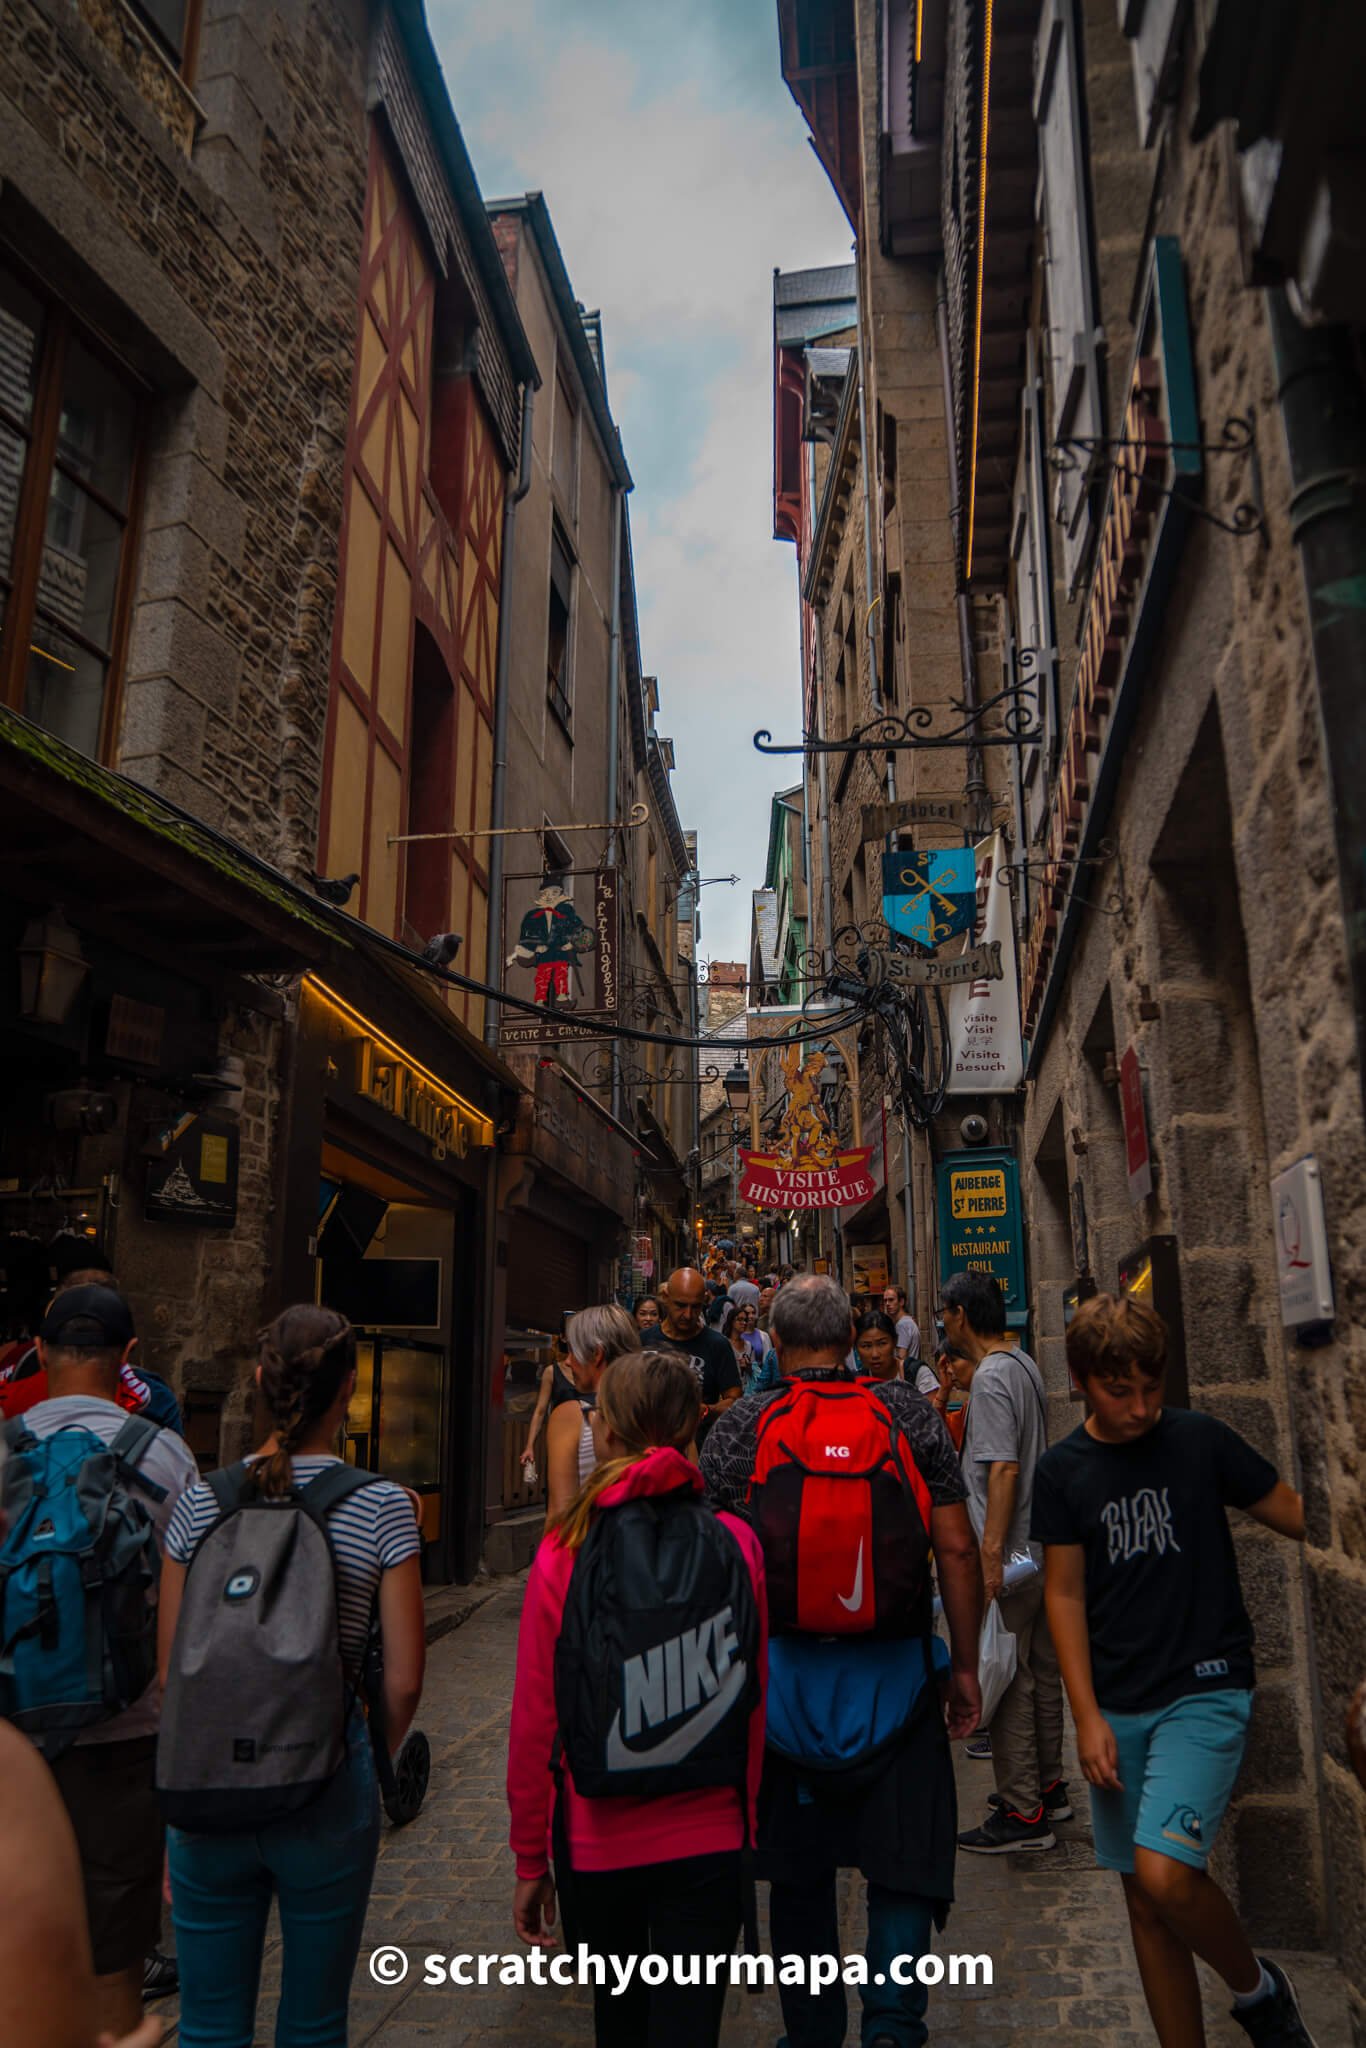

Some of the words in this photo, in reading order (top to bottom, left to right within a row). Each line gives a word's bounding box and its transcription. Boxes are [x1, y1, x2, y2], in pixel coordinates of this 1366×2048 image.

[889, 960, 911, 979] St
[926, 964, 979, 980] Pierre
[960, 1050, 1001, 1060] Visita
[955, 1062, 1006, 1072] Besuch
[775, 1170, 841, 1189] VISITE
[955, 1176, 1001, 1191] AUBERGE
[747, 1181, 869, 1207] HISTORIQUE
[968, 1196, 1005, 1212] PIERRE
[951, 1240, 1010, 1257] RESTAURANT
[825, 1445, 850, 1458] KG
[623, 1604, 739, 1739] NIKE
